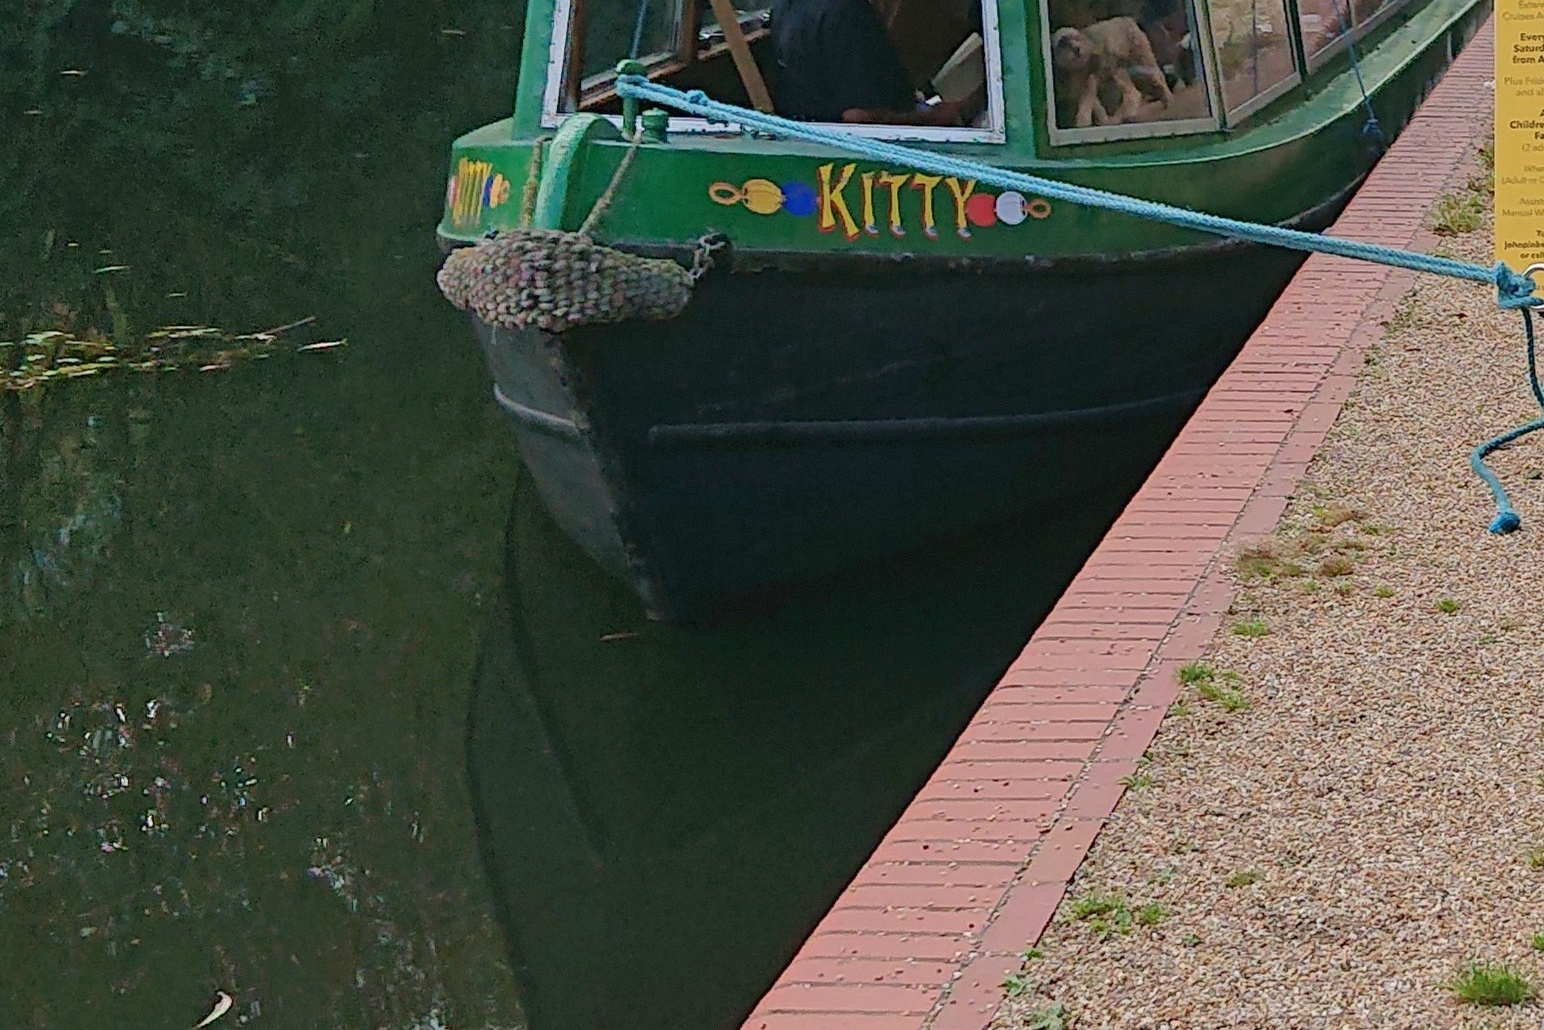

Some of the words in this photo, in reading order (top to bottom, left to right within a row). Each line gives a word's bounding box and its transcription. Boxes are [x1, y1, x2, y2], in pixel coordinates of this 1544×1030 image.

[1512, 55, 1535, 64] from
[1504, 77, 1523, 86] Plus
[1515, 88, 1534, 97] and
[817, 163, 977, 241] KITTY
[1531, 251, 1544, 259] call
